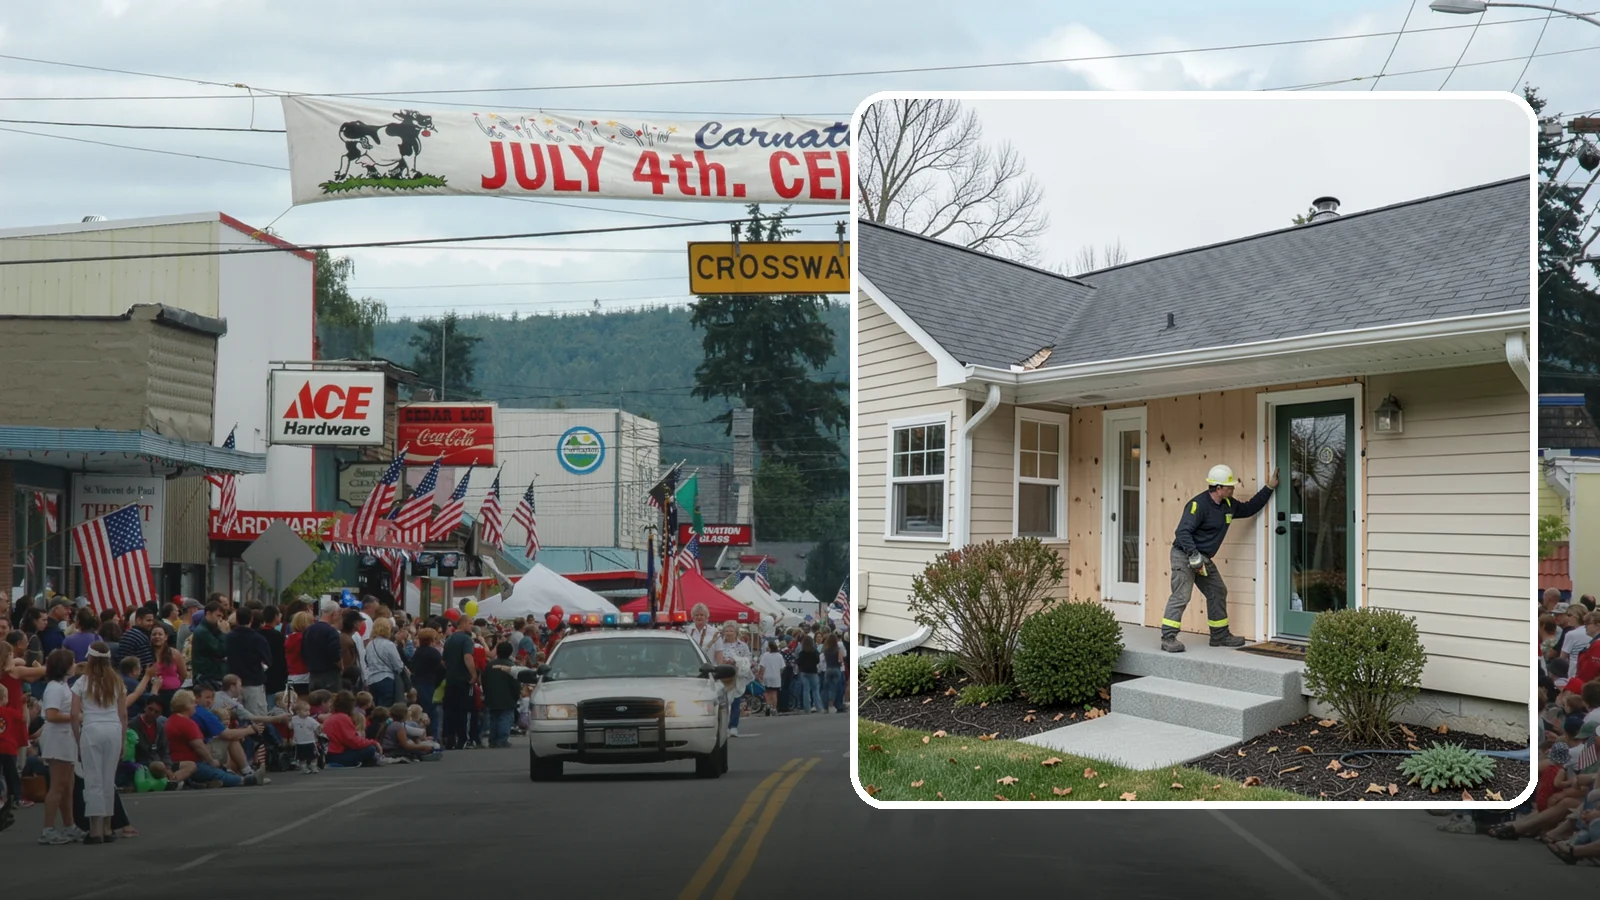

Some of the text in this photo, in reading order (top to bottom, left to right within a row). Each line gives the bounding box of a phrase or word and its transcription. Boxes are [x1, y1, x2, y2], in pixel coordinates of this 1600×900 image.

[481, 141, 604, 192] JULY
[632, 149, 746, 198] 4th.
[696, 254, 850, 280] CROSSWA
[283, 380, 373, 419] ACE
[405, 409, 453, 422] CEDAR
[284, 421, 371, 436] Hardware
[353, 467, 384, 481] Simpl
[95, 485, 124, 494] Vincent
[126, 486, 136, 494] de
[138, 486, 155, 495] Paul
[688, 527, 741, 535] CRNATION
[699, 535, 730, 543] GLASS
